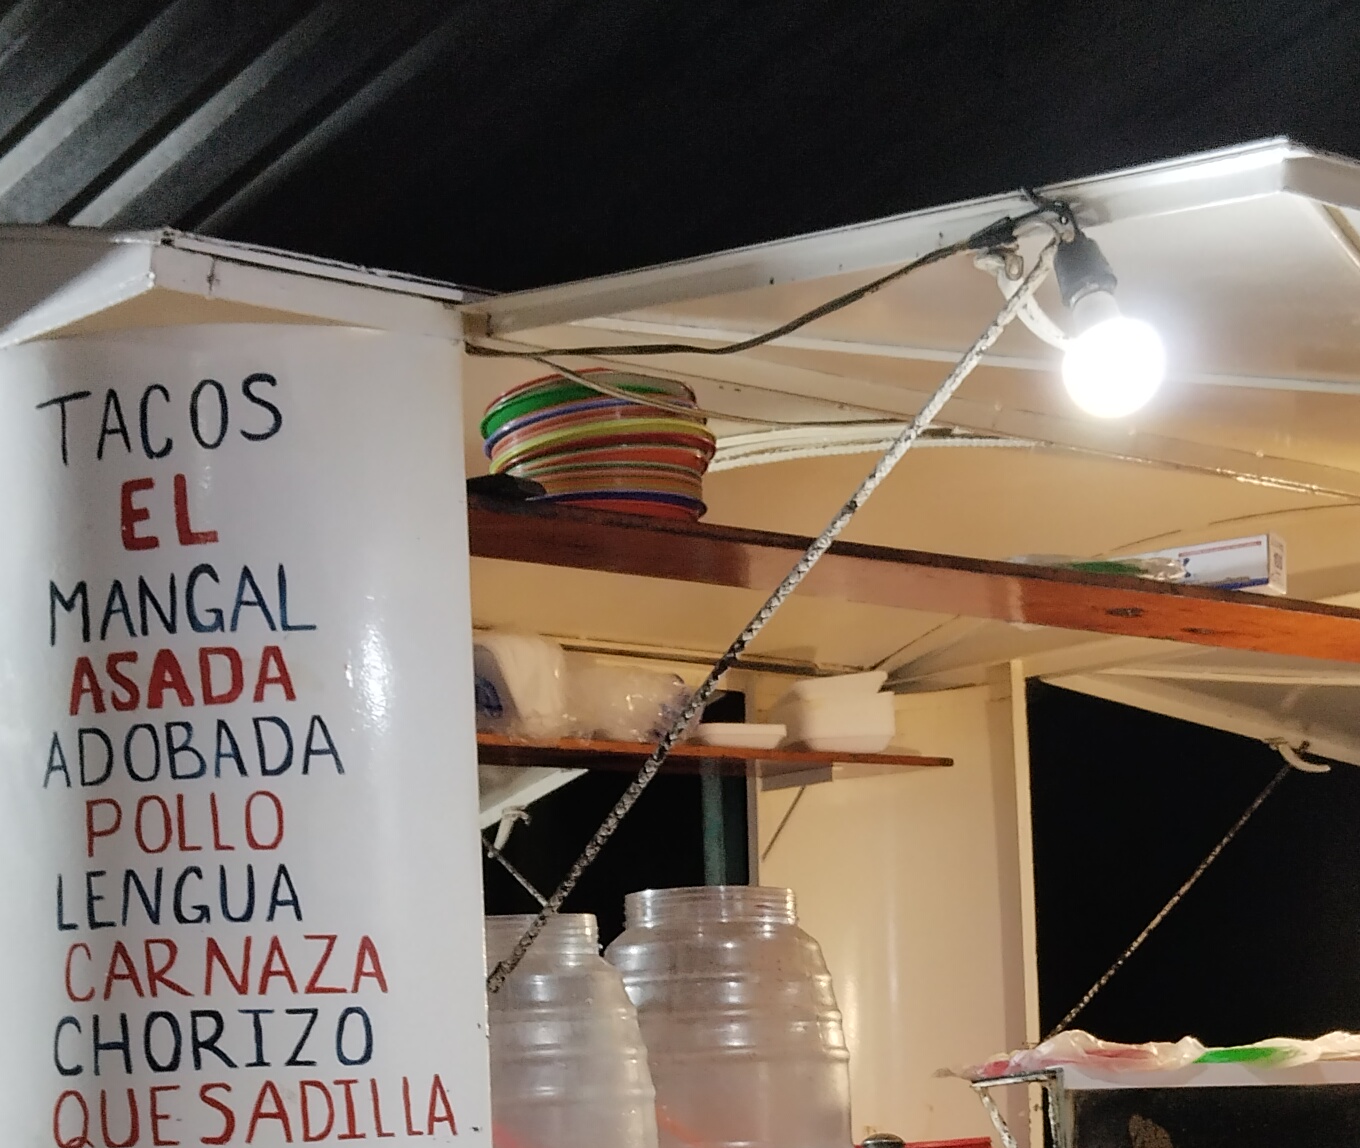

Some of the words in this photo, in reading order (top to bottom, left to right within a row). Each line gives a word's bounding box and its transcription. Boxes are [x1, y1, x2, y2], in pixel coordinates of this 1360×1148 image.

[34, 371, 283, 466] TACOS
[120, 474, 219, 551] EL
[49, 562, 318, 648] MANGAL
[69, 644, 297, 716] ASADA
[42, 713, 346, 790] ADOBADA
[85, 790, 285, 858] POLLO
[55, 863, 303, 932] LENGUA
[64, 933, 389, 1003] CARNAZA
[53, 1006, 374, 1077] CHORIZO
